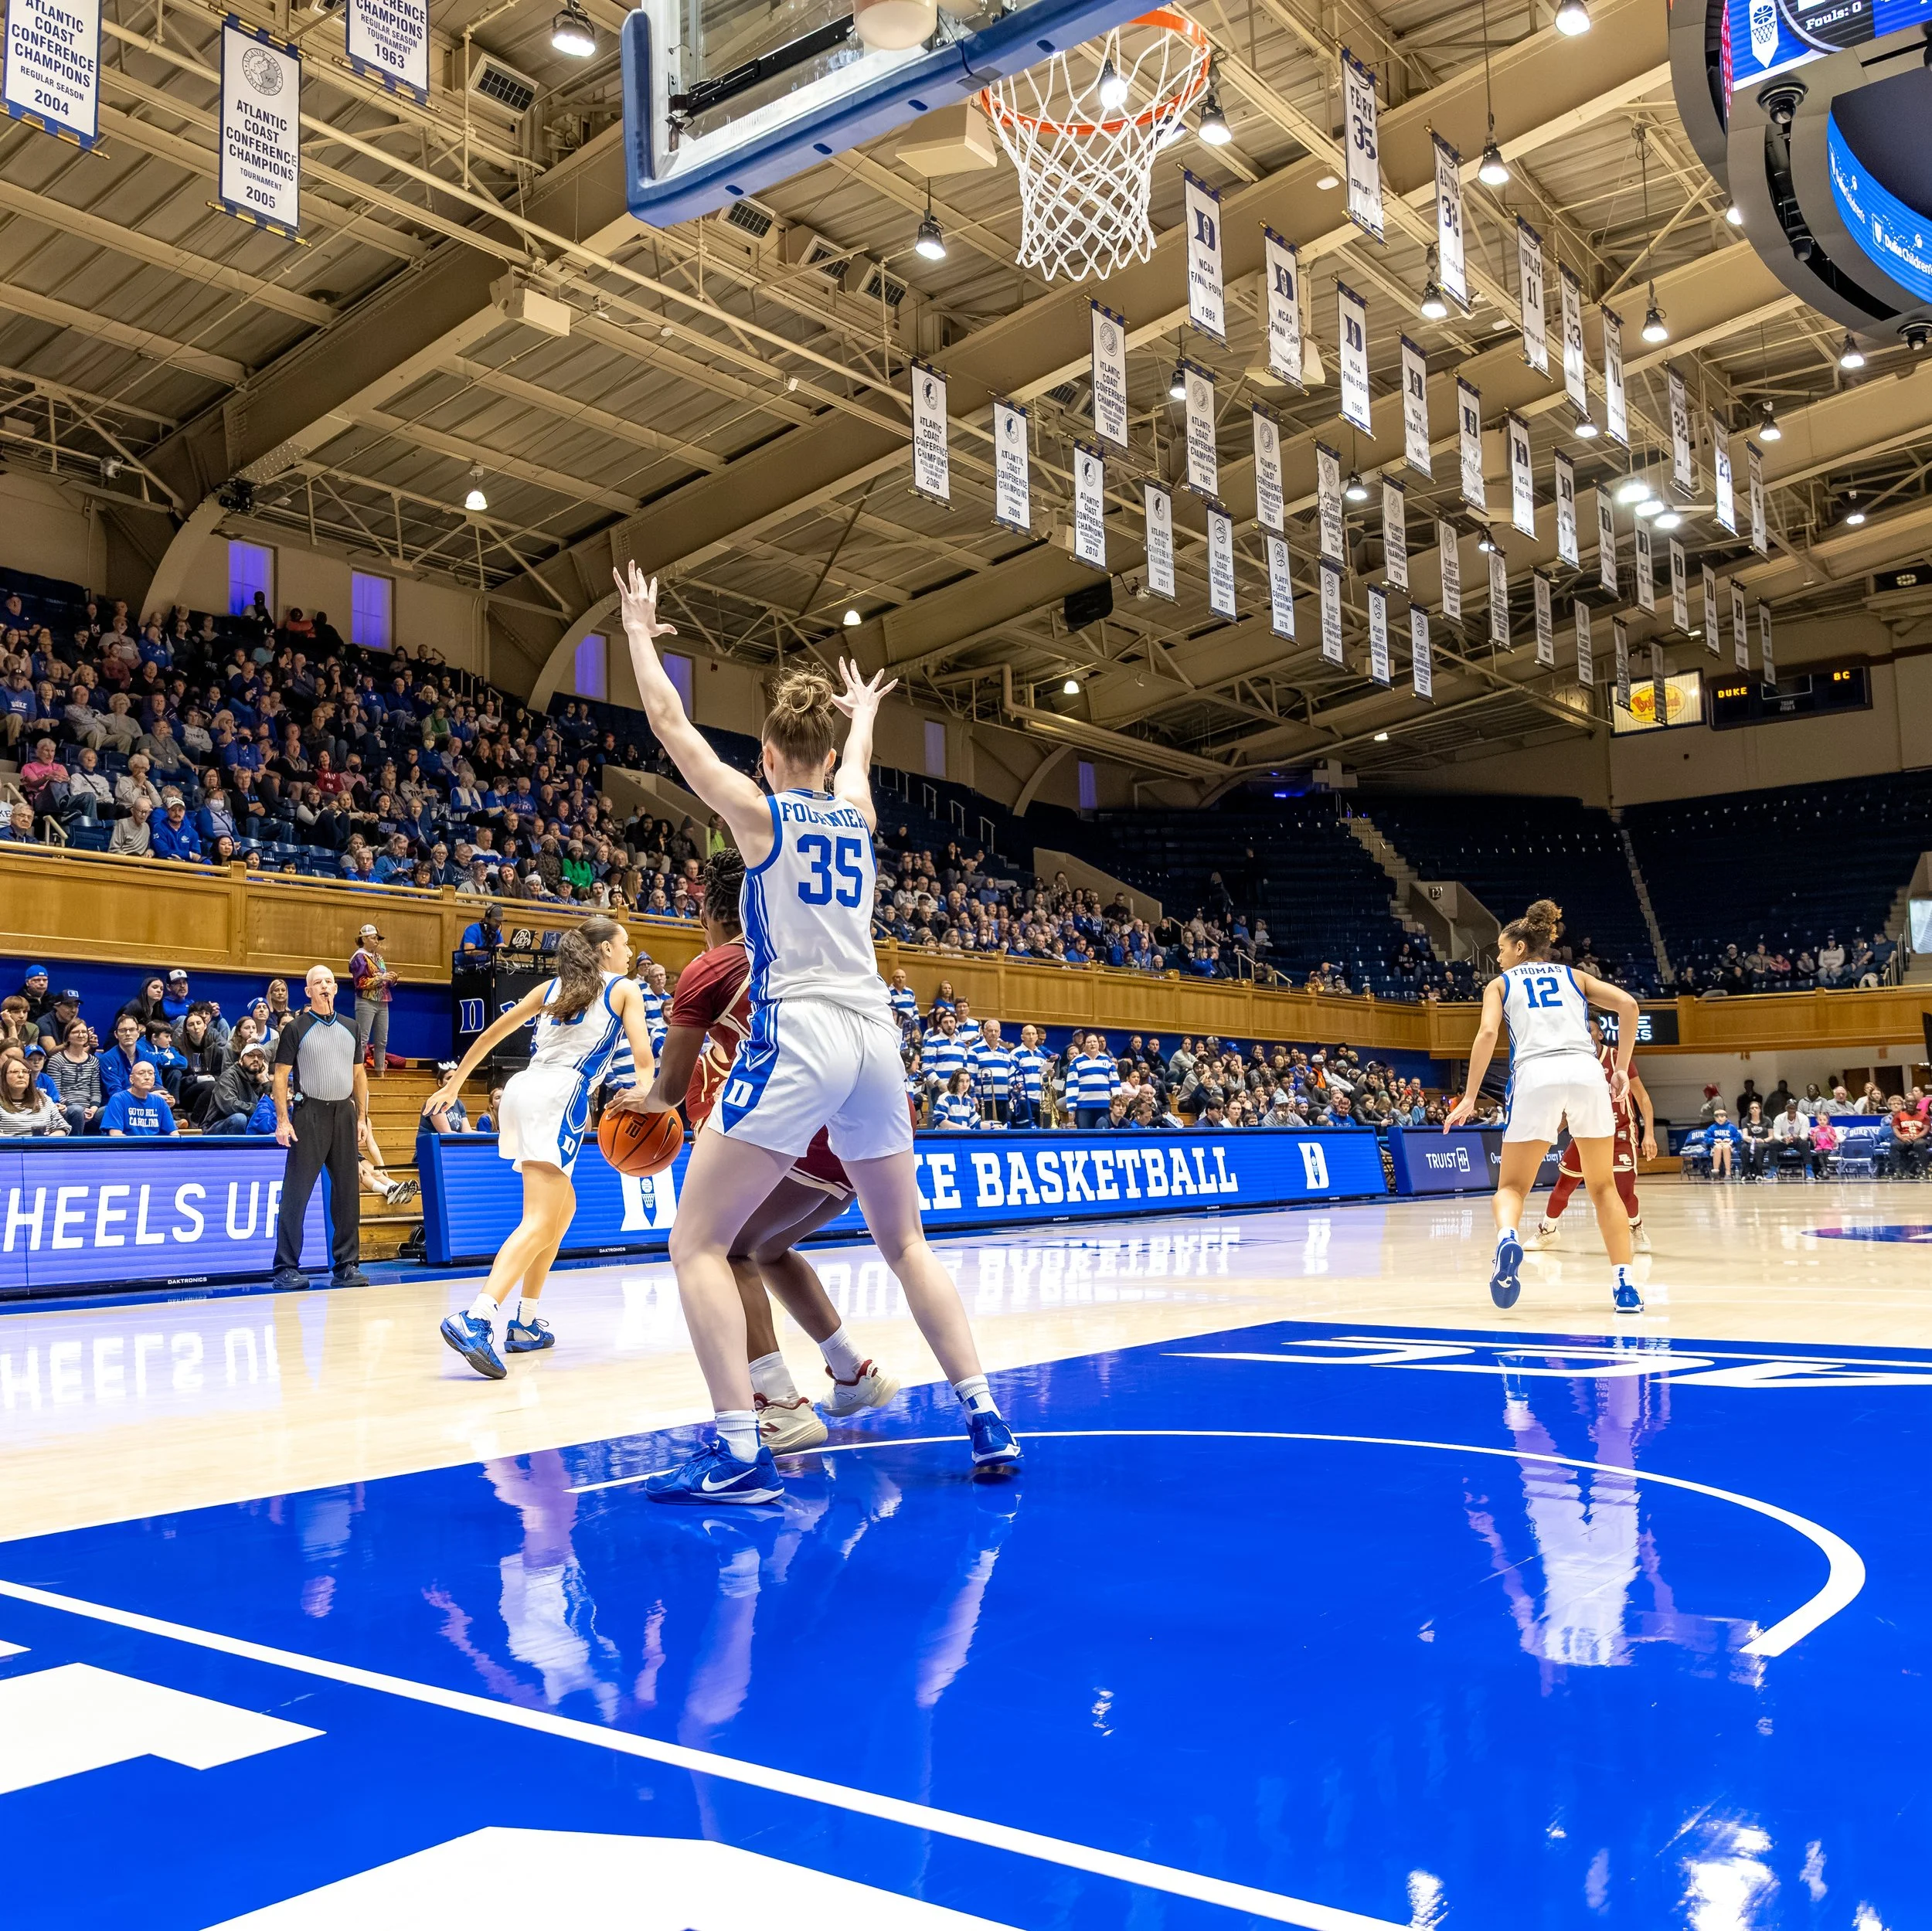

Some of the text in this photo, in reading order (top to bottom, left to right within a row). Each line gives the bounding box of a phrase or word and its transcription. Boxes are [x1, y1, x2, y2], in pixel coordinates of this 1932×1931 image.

[26, 0, 83, 33] ATLANTIC
[356, 0, 423, 39] CHAMPIONS
[377, 0, 425, 24] RENCE
[1805, 2, 1862, 31] Fouls: 0
[35, 16, 75, 45] COAST
[361, 14, 417, 48] REGULAR SEASON
[367, 26, 411, 55] TOURNAMENT
[12, 24, 94, 73] CONFERENCE
[375, 43, 405, 69] 1963
[15, 42, 90, 88] CHAMPIONS
[20, 66, 84, 101] REGULAR SEASON
[34, 89, 70, 116] 2004
[236, 99, 287, 131] ATLANTIC
[244, 119, 280, 144] COAST
[1352, 114, 1376, 160] 35
[226, 126, 297, 168] CONFERENCE
[229, 144, 294, 181] CHAMPIONS
[240, 168, 282, 191] TOURNAMENT
[246, 185, 276, 209] 2005
[1885, 234, 1902, 257] Duke
[1199, 258, 1214, 276] NCAA
[1191, 271, 1208, 291] FINAL
[1527, 276, 1538, 309] 11
[1201, 306, 1216, 322] 1988
[1278, 309, 1292, 325] NCAA
[1100, 360, 1121, 380] ATLANTIC
[1349, 359, 1361, 375] NCAA
[1103, 373, 1118, 389] COAST
[1343, 370, 1355, 387] FINAL
[1096, 380, 1126, 405] CONFERENCE
[1097, 393, 1125, 416] CHAMPIONS
[1352, 402, 1362, 416] 1990
[920, 416, 942, 434] ATLANTIC
[923, 429, 940, 443] COAST
[917, 436, 947, 458] CONFERENCE
[918, 448, 947, 468] CHAMPIONS
[1002, 450, 1023, 467] ATLANTIC
[1007, 461, 1021, 475] COAST
[998, 469, 1028, 490] CONFERENCE
[998, 481, 1027, 500] CHAMPIONS
[1009, 506, 1021, 519] 2009
[1085, 546, 1098, 557] 2010
[1834, 671, 1850, 680] BC
[1718, 687, 1747, 698] DUKE
[797, 834, 862, 908] 35
[1432, 887, 1441, 898] 12
[1511, 966, 1562, 976] THOMAS
[1522, 977, 1563, 1008] 12
[1598, 1015, 1651, 1030] DUE
[128, 1107, 136, 1116] GO
[129, 1117, 159, 1127] CAROLINA
[1426, 1152, 1456, 1168] TRUIST
[971, 1147, 1239, 1208] BASKETBALL
[0, 1183, 206, 1253] HEELS
[167, 1277, 207, 1285] DAKTRONICS
